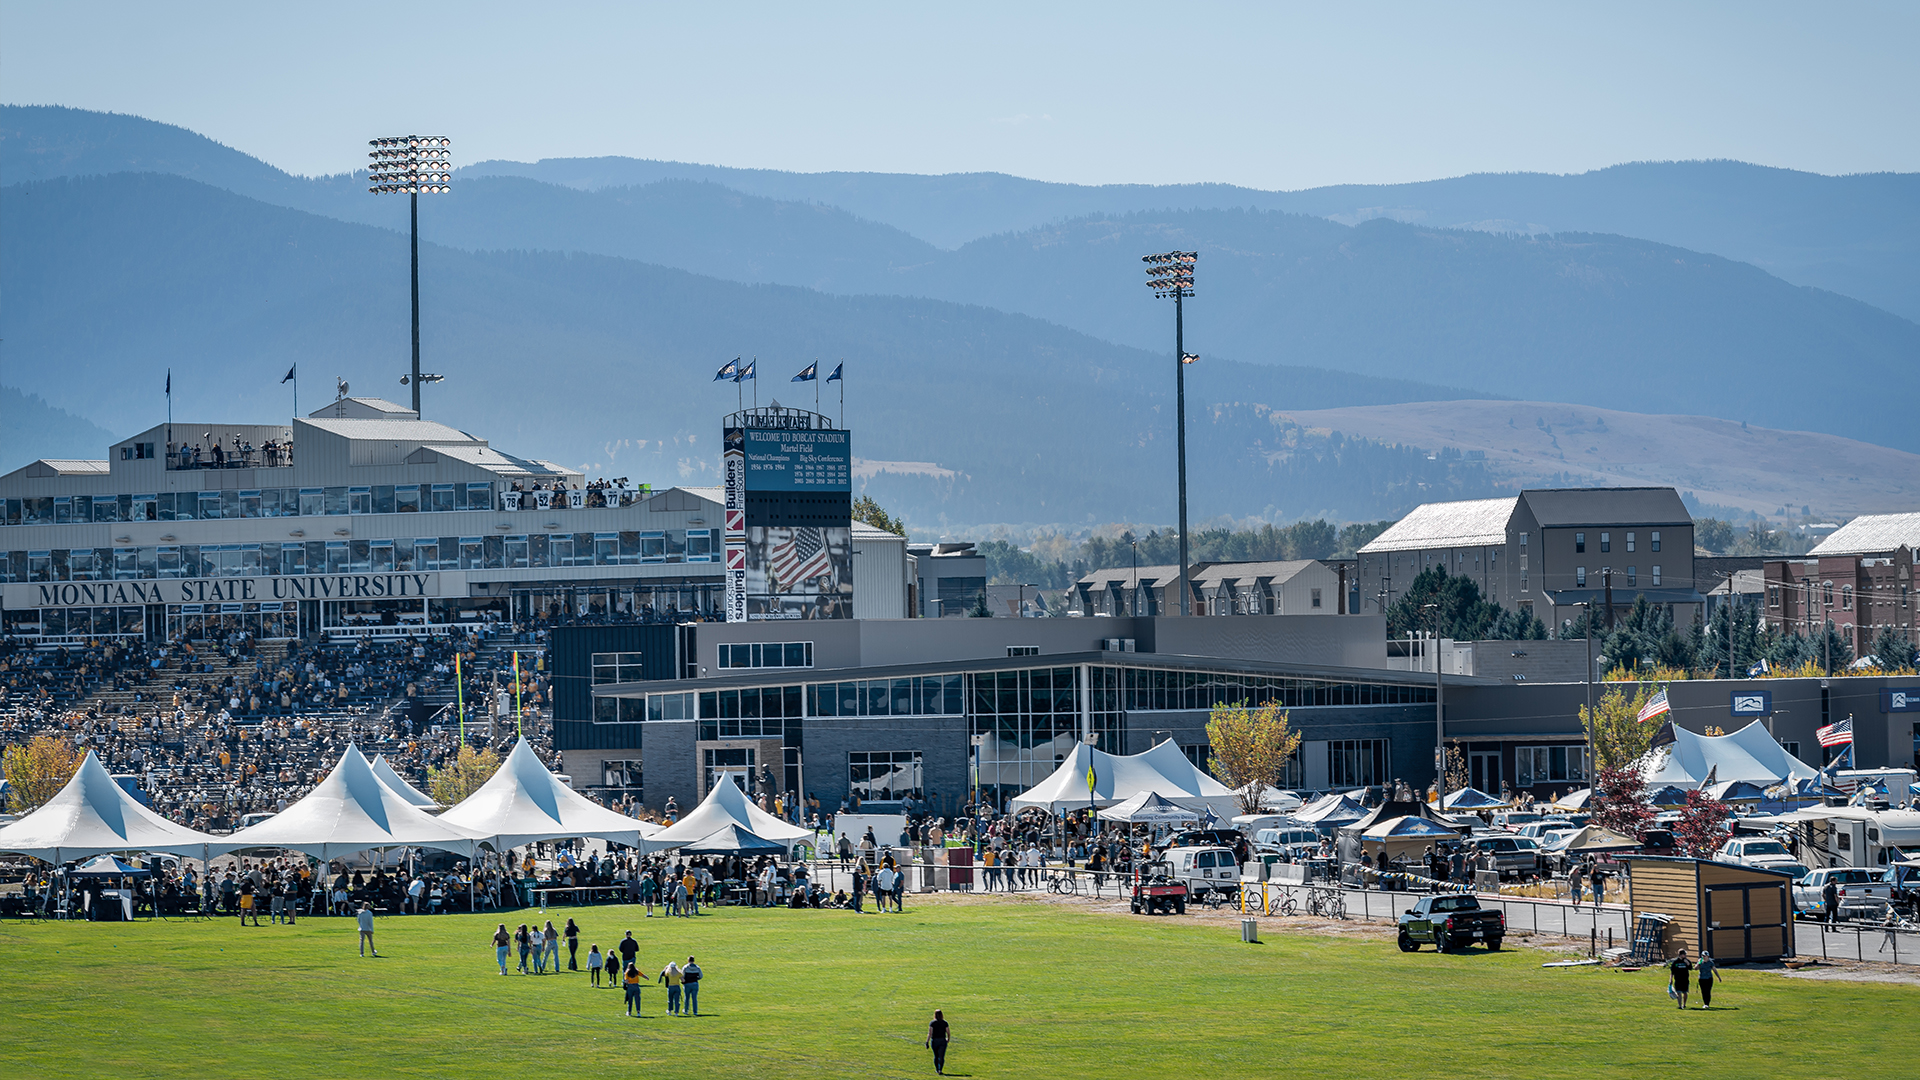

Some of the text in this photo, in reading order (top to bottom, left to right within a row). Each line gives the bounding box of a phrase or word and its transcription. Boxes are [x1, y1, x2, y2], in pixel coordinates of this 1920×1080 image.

[749, 432, 845, 443] WELCOME TO BOBCAT STADIUM
[781, 444, 813, 453] Martel Field
[748, 453, 790, 463] National Champions
[800, 454, 844, 463] Big Sky Conference
[726, 460, 736, 509] Builders
[736, 459, 744, 510] FirstSource
[506, 497, 516, 508] 78
[538, 496, 549, 507] 52
[572, 495, 582, 506] 21
[608, 494, 618, 505] 77
[38, 574, 430, 607] MONTANA STATE UNIVERSITY
[727, 570, 735, 620] FirstSource
[735, 570, 745, 620] Builders
